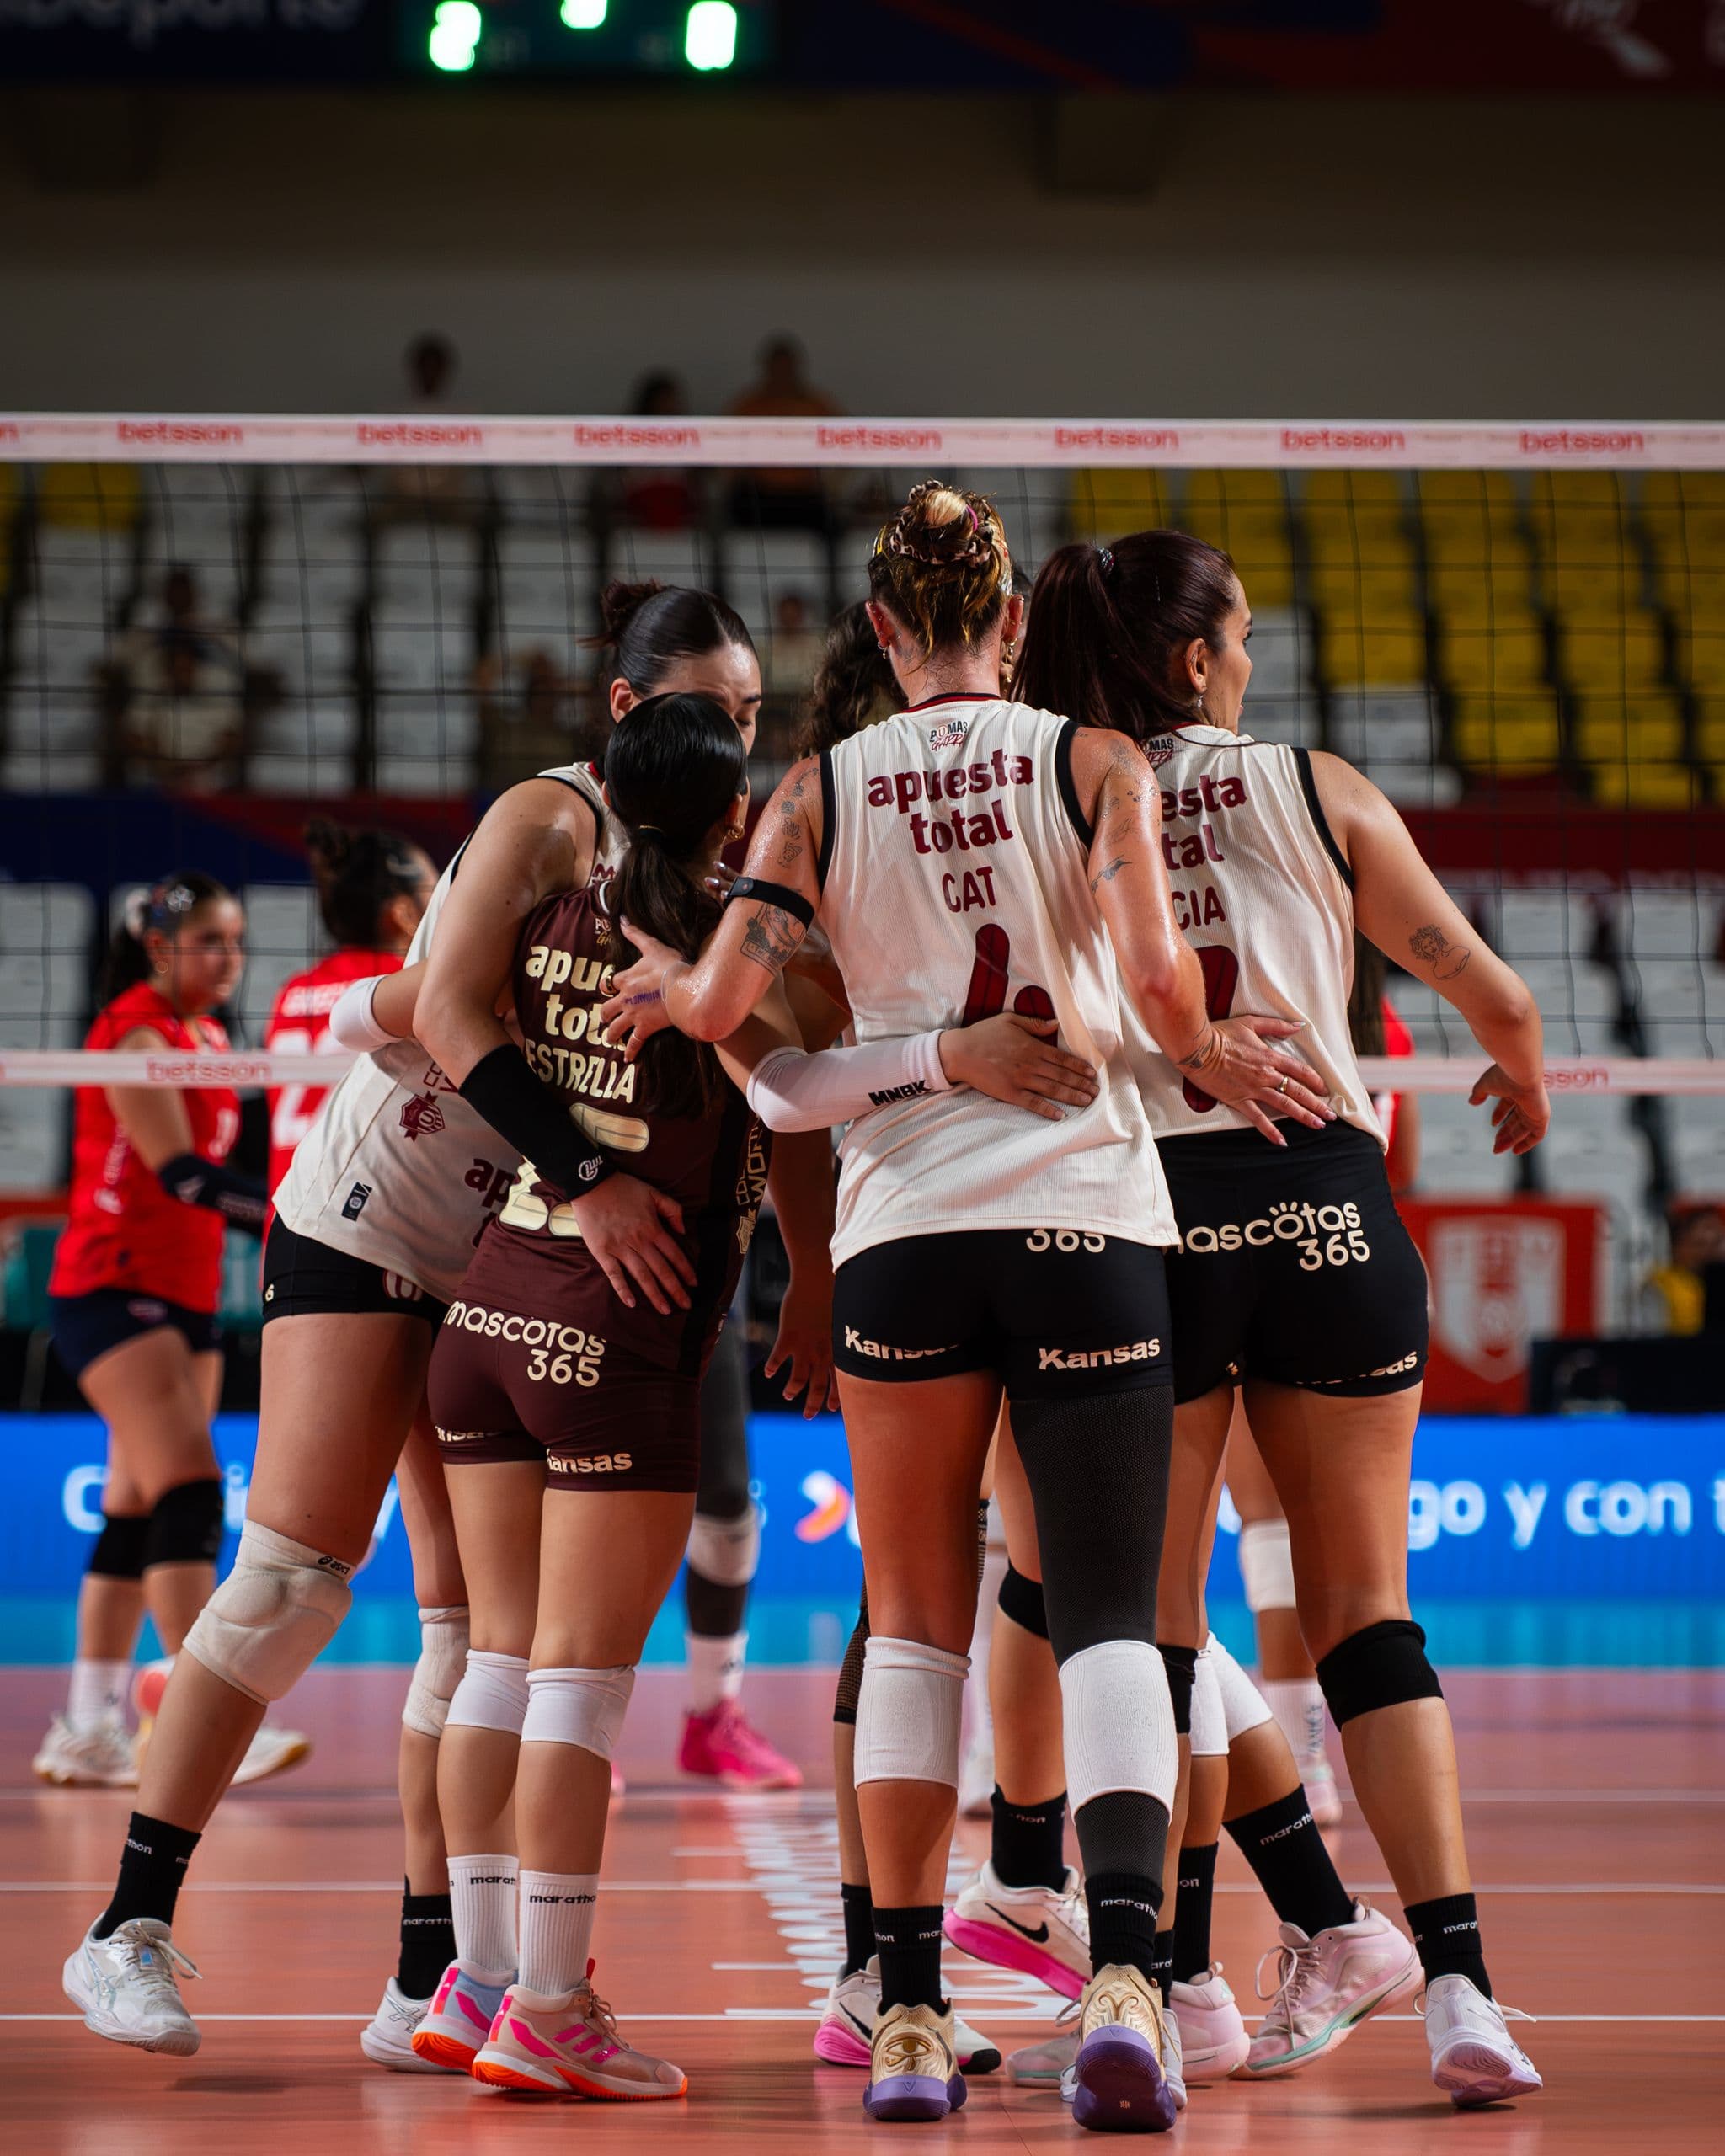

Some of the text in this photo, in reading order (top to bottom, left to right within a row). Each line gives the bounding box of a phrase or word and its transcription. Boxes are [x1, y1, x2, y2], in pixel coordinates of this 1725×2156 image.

[117, 423, 243, 445] betsson
[357, 424, 483, 446] betsson
[574, 424, 701, 448] betsson
[815, 426, 943, 451] betsson
[1055, 427, 1178, 449] betsson
[1281, 429, 1405, 451] betsson
[1521, 430, 1644, 453] betsson
[930, 720, 968, 742] PUMAS
[1143, 738, 1173, 751] MAS
[867, 749, 1034, 814] apuesta
[1161, 774, 1247, 822] esta
[910, 799, 1014, 855] total
[1162, 824, 1225, 871] tal
[942, 866, 996, 913] CAT
[1172, 886, 1226, 931] CIA
[545, 994, 628, 1052] tot
[147, 1057, 272, 1083] betsson
[525, 1038, 636, 1104] ESTRELLA
[1542, 1068, 1610, 1088] sson
[868, 1079, 932, 1107] MNBK
[1176, 1201, 1361, 1255] ascotas
[1296, 1230, 1370, 1271] 365
[442, 1299, 606, 1357] mascotas
[1039, 1337, 1161, 1371] Kansas
[526, 1349, 601, 1388] 365
[1502, 1479, 1548, 1550] y
[1563, 1479, 1693, 1537] con
[529, 1893, 596, 1904] maratho
[1100, 1898, 1159, 1920] maratho
[1443, 1920, 1478, 1935] mara
